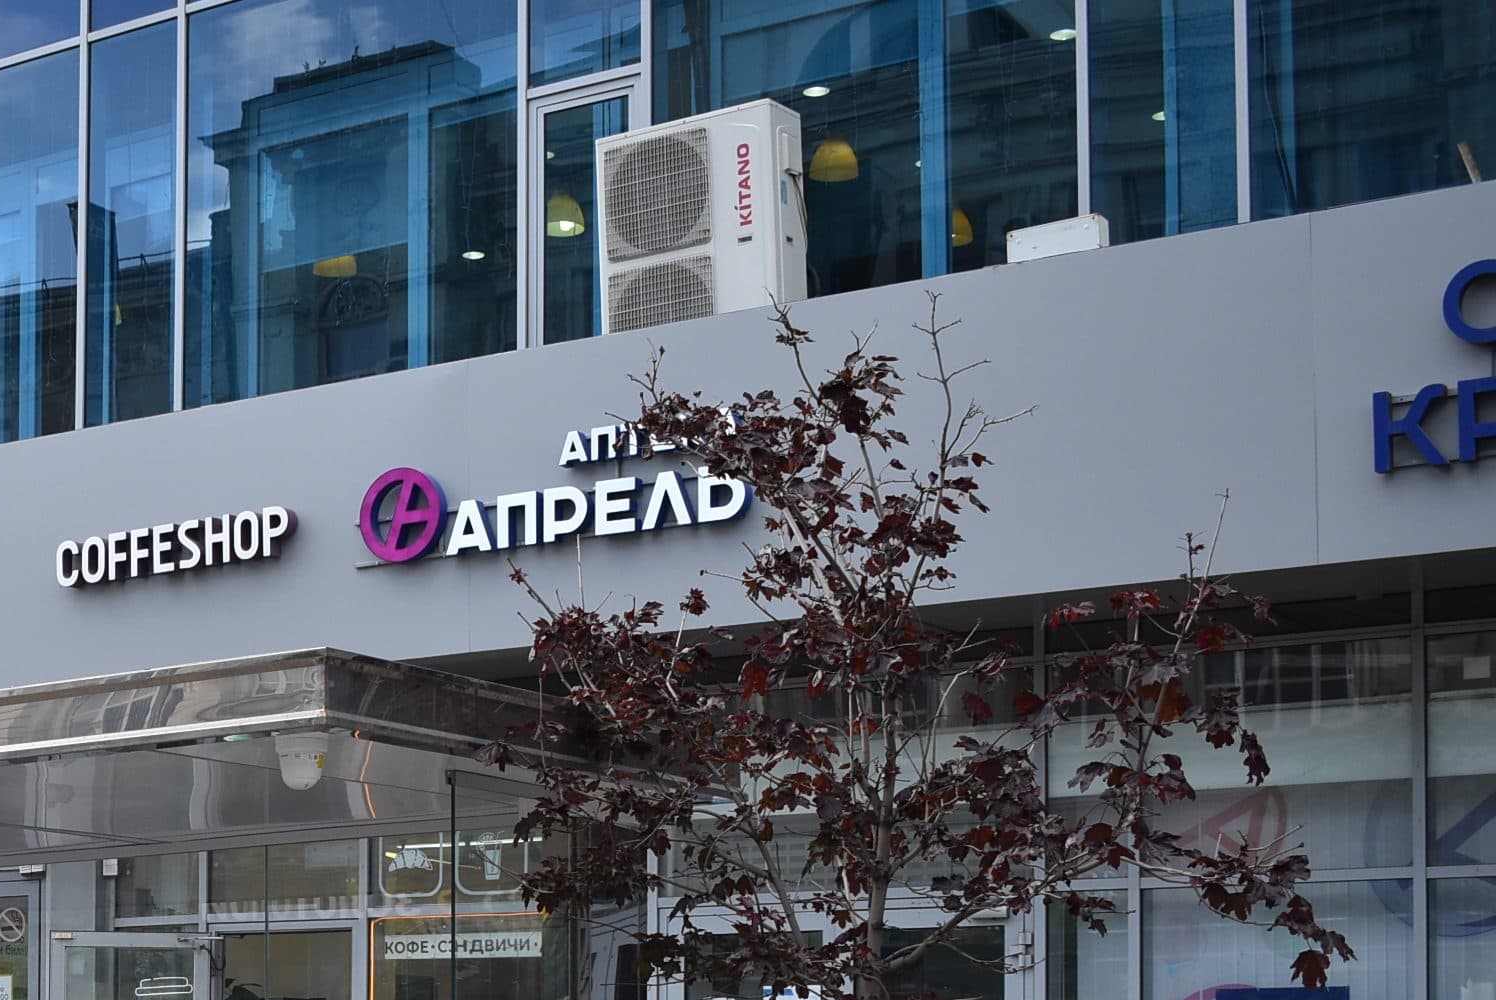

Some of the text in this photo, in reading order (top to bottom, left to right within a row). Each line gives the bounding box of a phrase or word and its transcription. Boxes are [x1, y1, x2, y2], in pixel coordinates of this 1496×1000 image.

[55, 505, 294, 590] COFFESHOP
[445, 465, 754, 557] АПРЕЛЬ
[385, 940, 429, 954] КОФЕ
